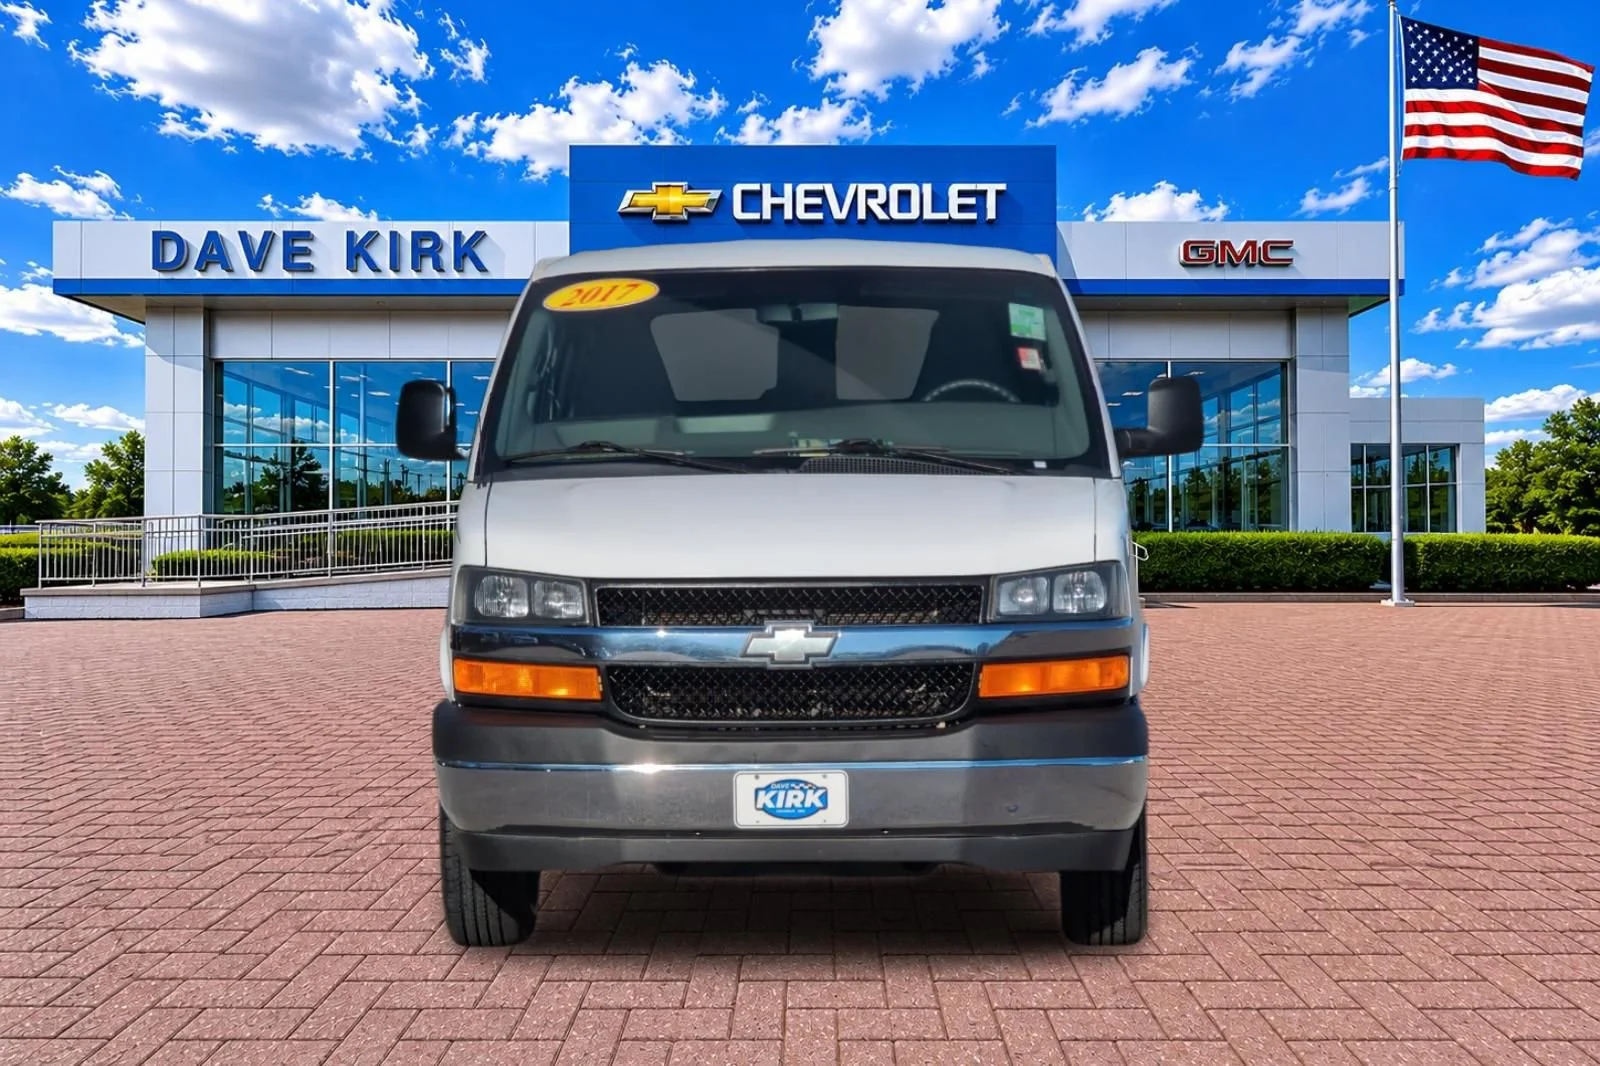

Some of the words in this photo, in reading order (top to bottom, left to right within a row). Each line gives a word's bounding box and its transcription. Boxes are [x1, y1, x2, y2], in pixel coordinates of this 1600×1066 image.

[732, 183, 1007, 222] CHEVROLET
[152, 230, 315, 272] DAVE
[346, 230, 489, 272] KIRK
[1180, 239, 1295, 267] GMC
[560, 283, 641, 307] 2017
[756, 789, 826, 809] KIRK
